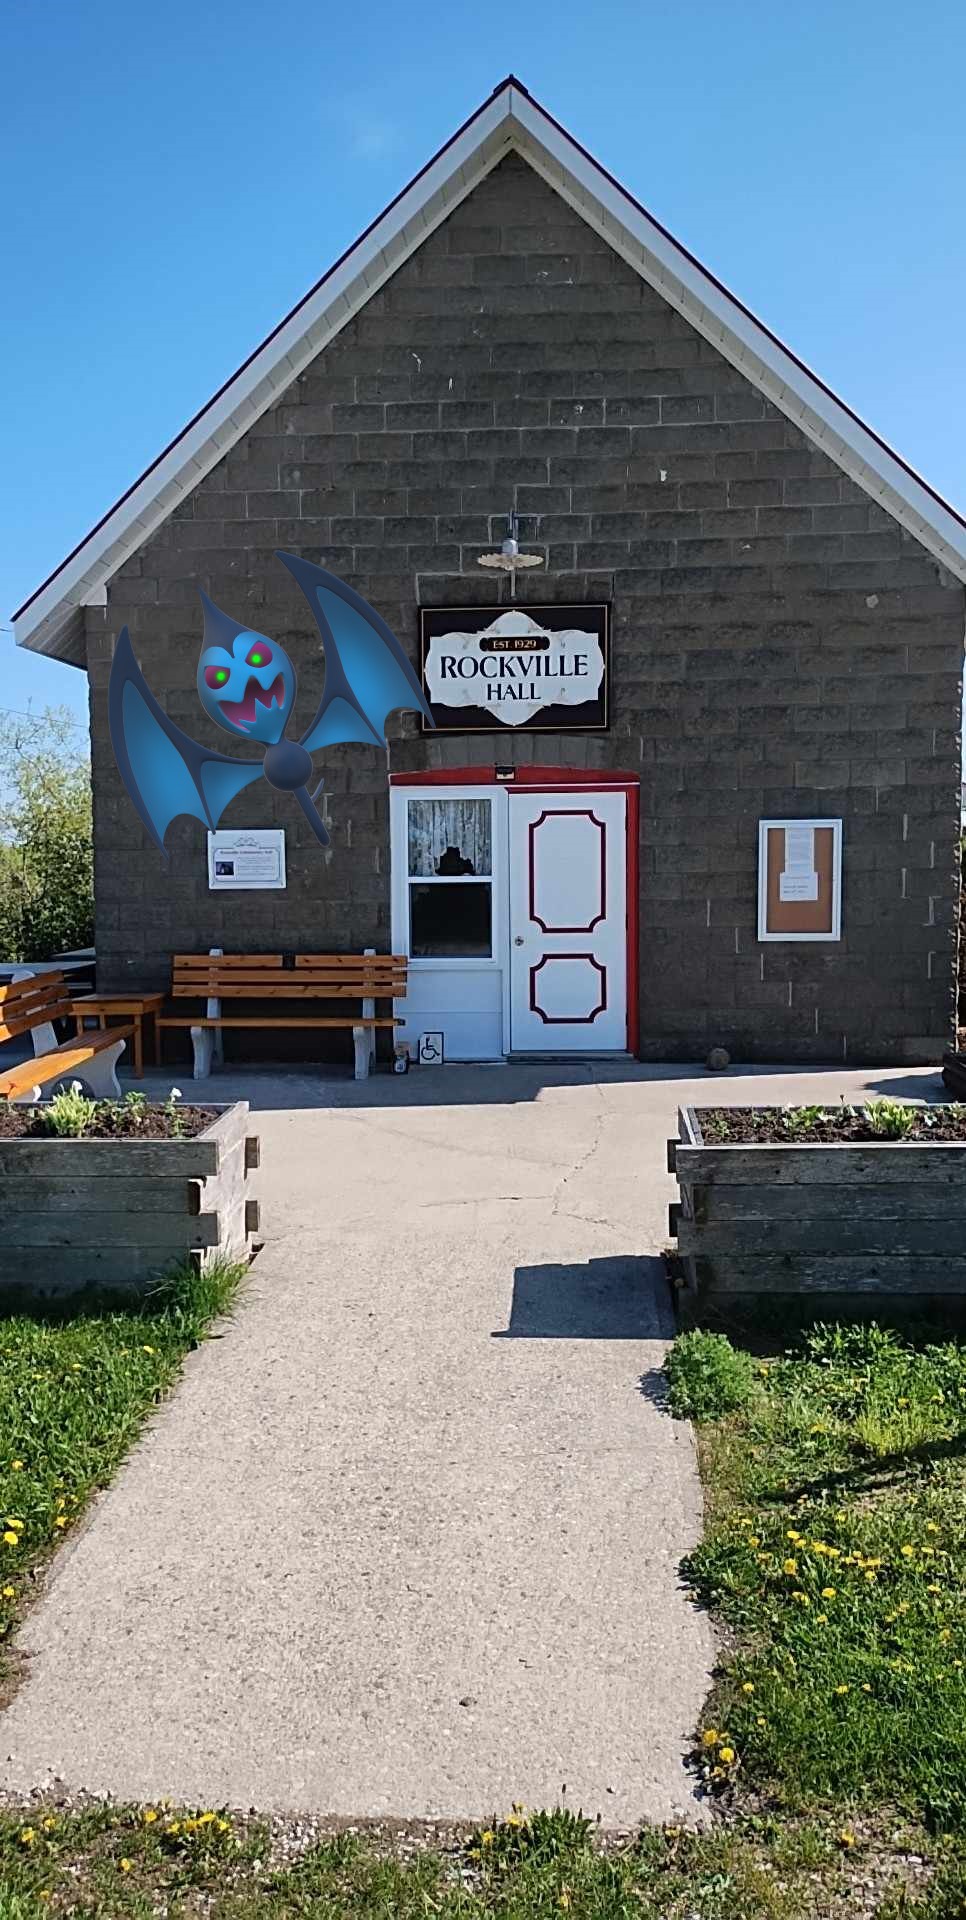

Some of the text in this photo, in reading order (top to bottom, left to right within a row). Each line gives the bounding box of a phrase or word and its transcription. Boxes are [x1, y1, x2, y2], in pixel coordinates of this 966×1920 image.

[493, 639, 537, 649] EST. 1929
[440, 654, 589, 679] ROCKVILLE
[487, 682, 541, 701] HALL
